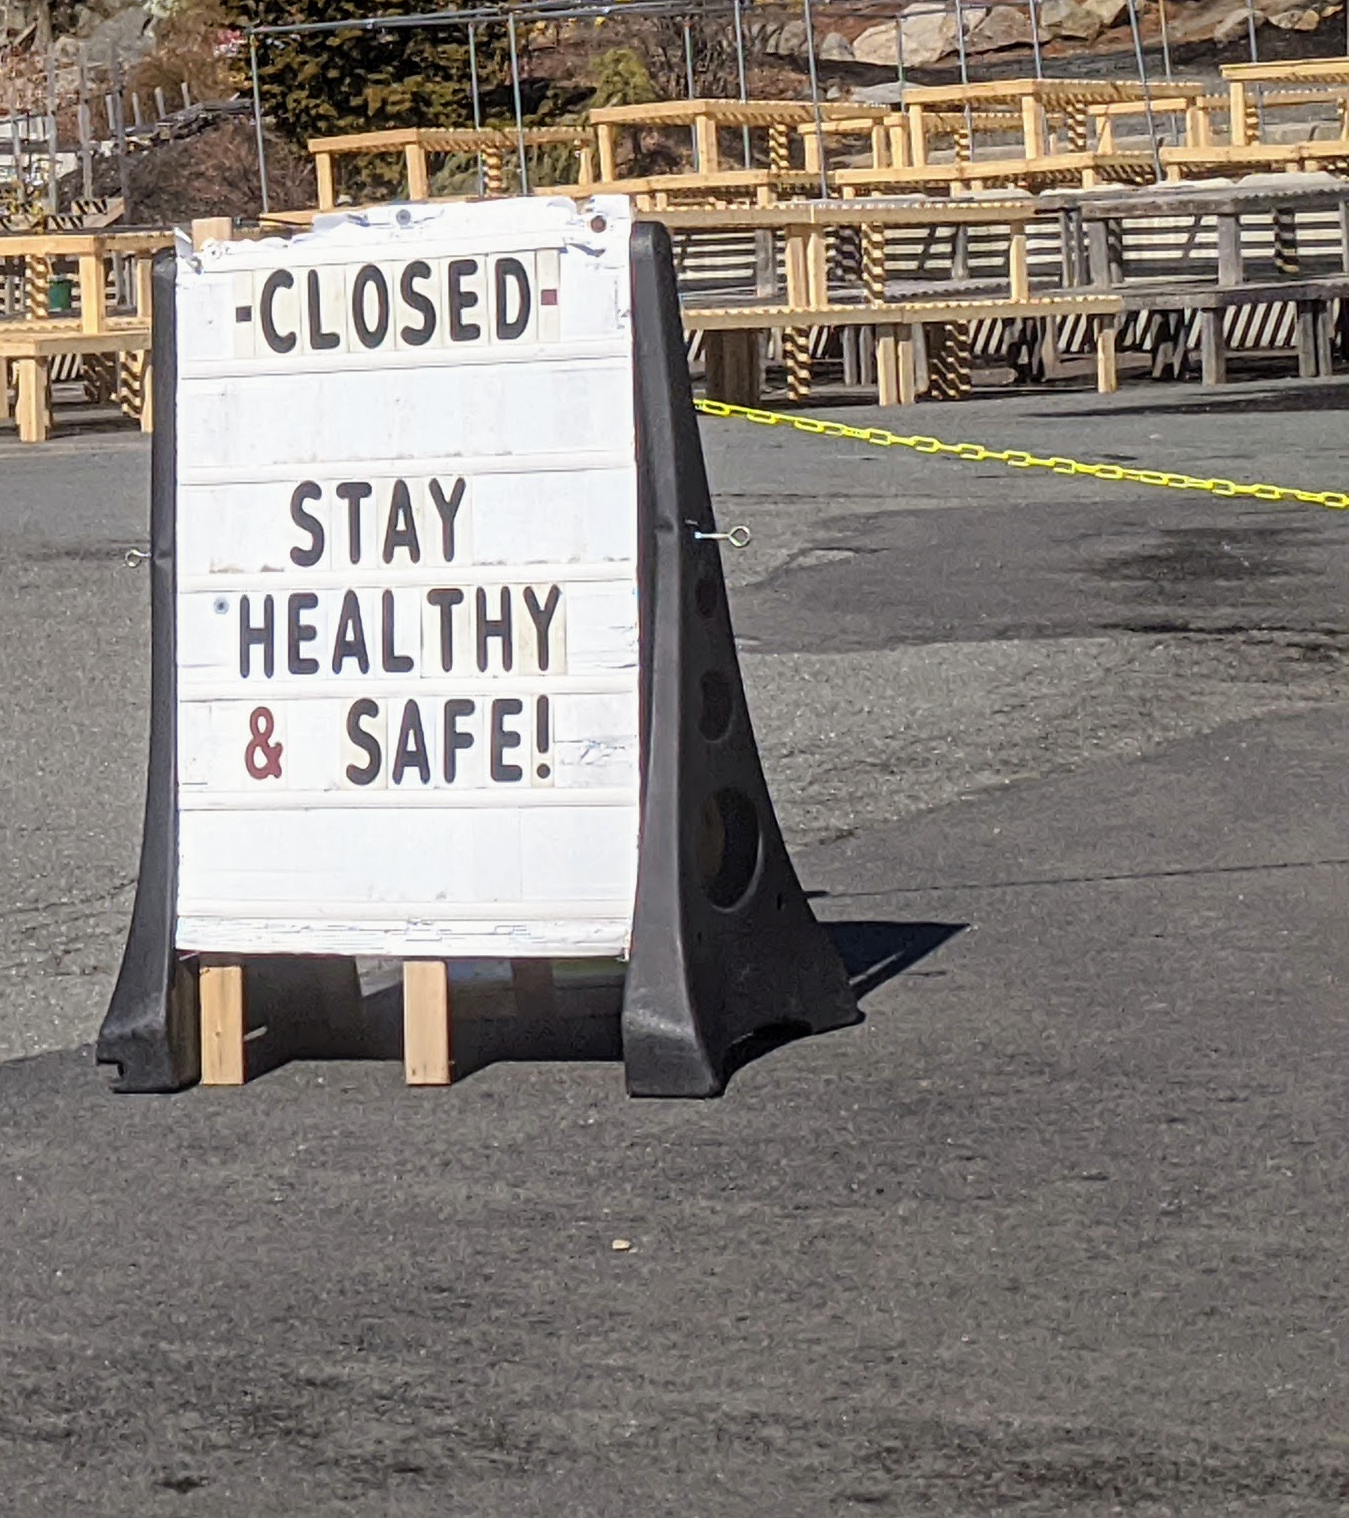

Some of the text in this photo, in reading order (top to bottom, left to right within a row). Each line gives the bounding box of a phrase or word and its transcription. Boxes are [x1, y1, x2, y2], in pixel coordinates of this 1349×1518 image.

[289, 477, 466, 567] STAY
[239, 584, 561, 679] HEALTHY
[245, 694, 551, 786] & SAFE!
